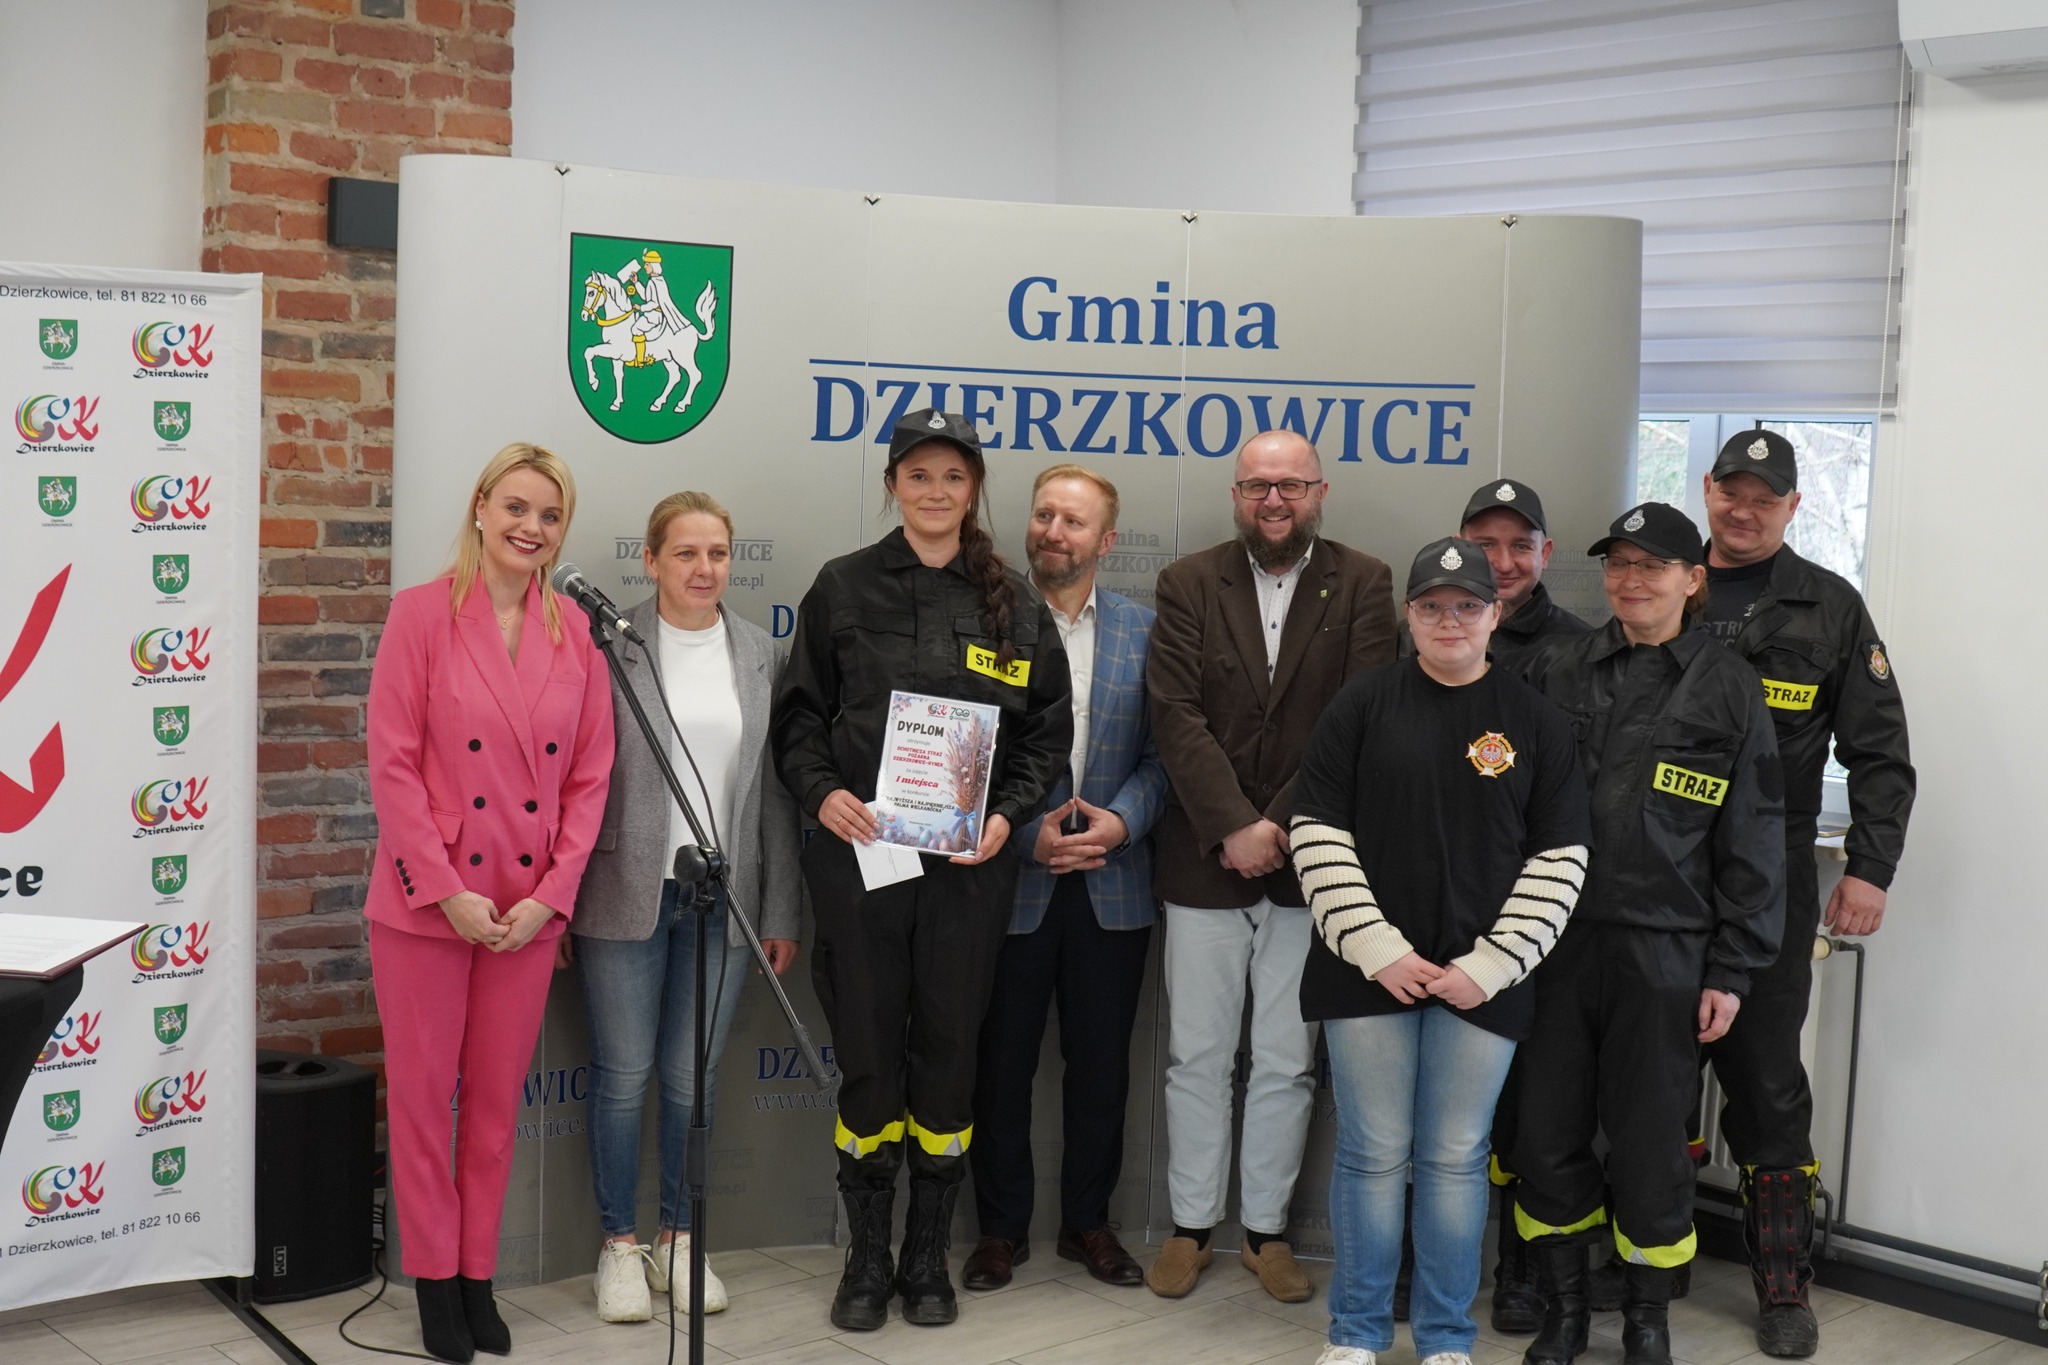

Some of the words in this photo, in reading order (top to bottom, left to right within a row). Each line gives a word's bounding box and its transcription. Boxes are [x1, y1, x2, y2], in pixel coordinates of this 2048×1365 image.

[0, 285, 92, 301] Dzierzkowice,
[97, 290, 116, 300] tel.
[121, 291, 136, 302] 81
[141, 292, 166, 304] 822
[172, 294, 187, 305] 10
[190, 294, 207, 306] 66
[1007, 276, 1280, 350] Gmina
[133, 368, 208, 378] Dzierzkowice
[16, 443, 94, 454] Dzierzkowice
[131, 522, 206, 533] Dzierzkowice
[132, 674, 206, 686] Dzierzkowice
[897, 720, 944, 737] DYPLOM
[901, 777, 938, 788] miejsca
[132, 823, 204, 838] Dzierzkowice
[132, 968, 204, 984] Dzierzkowice
[135, 1115, 202, 1137] Dzierzkowice
[24, 1208, 100, 1228] Dzierzkowice
[8, 1234, 97, 1256] Dzierzkowice,
[101, 1228, 118, 1240] tel.
[122, 1222, 136, 1236] 81
[138, 1216, 161, 1230] 822
[166, 1213, 180, 1224] 10
[184, 1212, 201, 1223] 66
